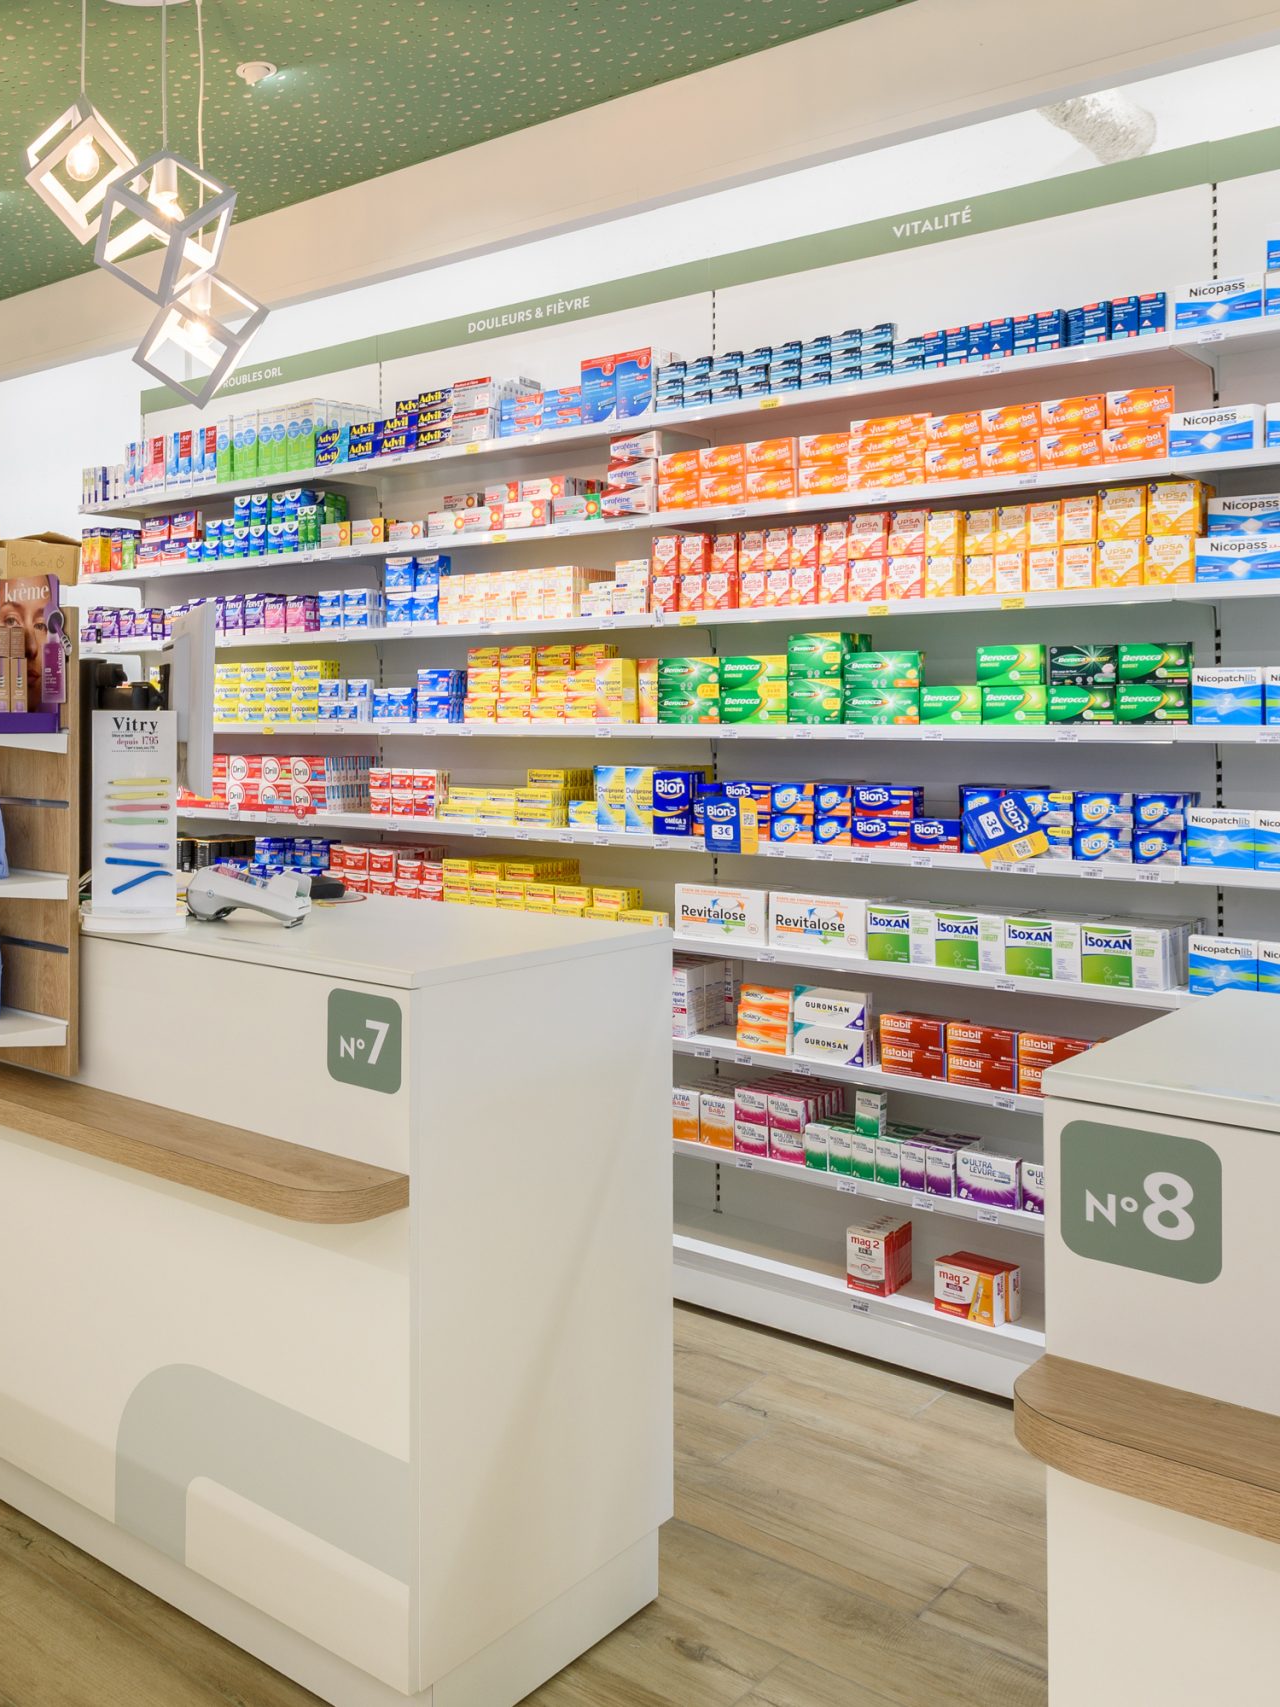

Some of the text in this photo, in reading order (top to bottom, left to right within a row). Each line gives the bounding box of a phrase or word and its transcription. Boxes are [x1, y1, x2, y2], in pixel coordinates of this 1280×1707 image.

[892, 204, 973, 239] VITALITÉ
[1189, 281, 1246, 298] Nicopass
[468, 296, 591, 334] DOULEURS & FIÈVRE
[223, 366, 283, 388] ROUBLES ORL
[1113, 395, 1168, 416] Vitascorbol
[1046, 403, 1098, 425] Vitascorbol
[1183, 410, 1237, 427] Nicopass
[351, 422, 375, 436] Advil
[384, 416, 409, 430] Advil
[870, 416, 912, 434] Vitascorbol
[931, 419, 977, 440] Vitascorbol
[985, 412, 1035, 433] Vitascorbol
[350, 441, 372, 455] Advil
[382, 435, 406, 449] Advil
[867, 433, 909, 452] Vitascorbol
[1108, 431, 1161, 454] Vitascorbol
[750, 446, 789, 465] Vitascorbol
[804, 440, 848, 459] Vitascorbol
[1045, 440, 1096, 461] Vitascorbol
[704, 451, 741, 470] Vitascorbol
[864, 452, 906, 470] Vitascorbol
[930, 454, 977, 474] Vitascorbol
[985, 447, 1034, 467] Vitascorbol
[662, 459, 696, 476] Vitascorbol
[751, 476, 791, 495] Vitascorbol
[804, 472, 847, 491] Vitascorbol
[864, 471, 905, 488] Vitascorbol
[662, 487, 696, 505] Vitascorbol
[704, 481, 742, 499] Vitascorbol
[1222, 496, 1280, 511] Nicopass
[855, 521, 879, 530] UPSA
[896, 517, 921, 527] UPSA
[1210, 541, 1268, 553] Nicopass
[4, 581, 50, 603] krème
[980, 654, 1017, 662] Berocca
[1122, 653, 1162, 662] Berocca
[851, 662, 882, 670] Berocca
[1197, 673, 1257, 684] Nicopatchlib
[924, 694, 959, 703] Berocca
[986, 694, 1023, 702] Berocca
[1051, 696, 1089, 704] Berocca
[1120, 694, 1161, 704] Berocca
[112, 717, 159, 735] Vitry
[116, 737, 139, 748] depuis
[141, 736, 159, 746] 1795
[232, 764, 246, 774] Drill
[265, 765, 278, 775] Drill
[294, 767, 310, 777] Drill
[655, 777, 685, 793] Bion
[726, 786, 751, 796] Bion3
[229, 791, 243, 801] Drill
[295, 794, 309, 804] Drill
[859, 788, 889, 802] Bion3
[707, 805, 736, 816] Bion3
[1002, 799, 1029, 833] Bion3
[1081, 803, 1116, 815] Bion3
[1140, 806, 1170, 817] Bion3
[857, 818, 886, 832] Bion3
[1191, 815, 1251, 825] Nicopatchlib
[714, 826, 731, 836] -3€
[914, 823, 944, 836] Bion3
[1080, 837, 1115, 850] Bion3
[1138, 841, 1168, 852] Bion3
[681, 905, 746, 922] Revitalose
[776, 914, 845, 932] Revitalose
[1193, 943, 1253, 957] Nicopatchlib
[805, 1001, 850, 1014] GURONSAN
[804, 1037, 849, 1051] GURONSAN
[1021, 1067, 1041, 1078] rista
[708, 1101, 725, 1109] ULTRA
[970, 1157, 992, 1168] ULTRA
[970, 1166, 996, 1177] LEVURE
[851, 1236, 880, 1249] mag 2
[939, 1269, 970, 1285] mag 2
